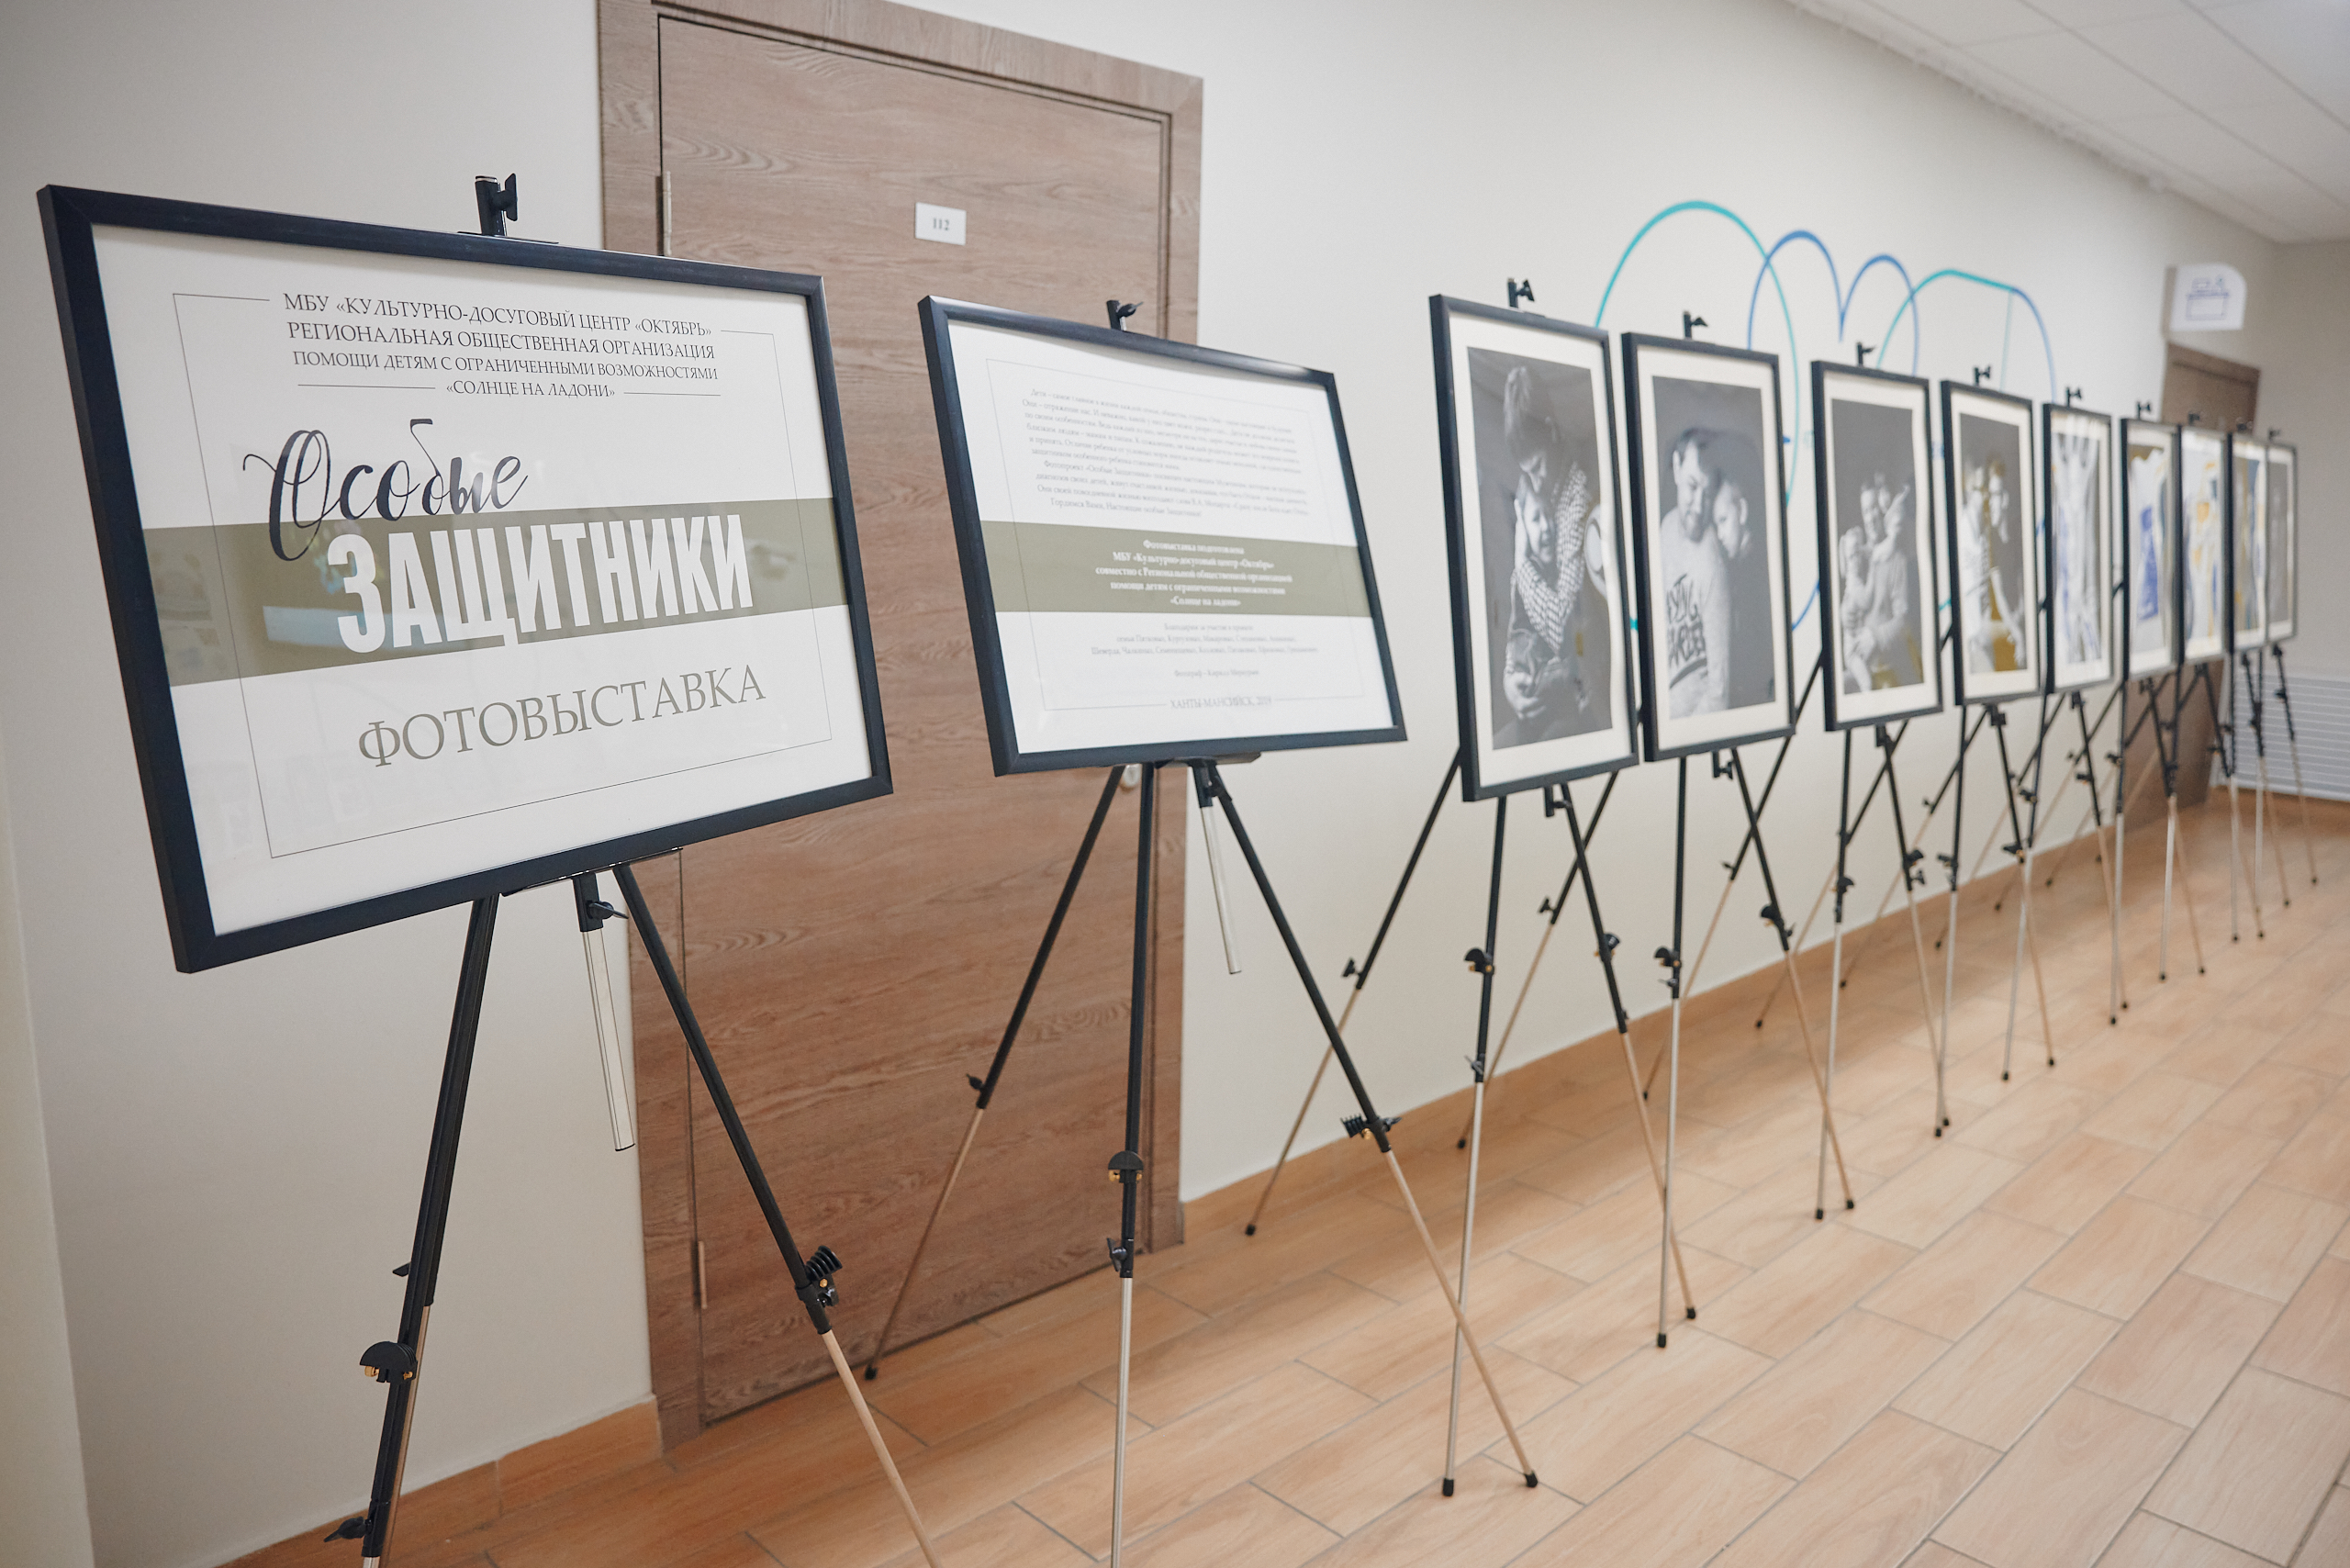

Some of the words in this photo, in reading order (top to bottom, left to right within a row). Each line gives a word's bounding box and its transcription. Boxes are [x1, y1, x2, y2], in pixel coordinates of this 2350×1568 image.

[933, 218, 950, 231] 112
[283, 293, 330, 312] МБУ
[336, 297, 575, 328] «КУЛЬТУРНО-ДОСУГОВЫЙ
[577, 314, 631, 332] ЦЕНТР
[635, 319, 711, 337] «ОКТЯБРЬ»
[287, 321, 453, 346] РЕГИОНАЛЬНАЯ
[457, 331, 599, 353] ОБЩЕСТВЕННАЯ
[602, 339, 715, 361] ОРГАНИЗАЦИЯ
[293, 351, 380, 370] ПОМОЩИ
[384, 354, 438, 371] ДЕТЯМ
[441, 356, 453, 371] С
[455, 357, 595, 375] ОГРАНИЧЕННЫМИ
[597, 363, 719, 380] ВОЗМОЖНОСТЯМИ
[446, 380, 519, 398] «СОЛНЦЕ
[521, 382, 544, 396] НА
[548, 383, 615, 398] ЛАДОНИ»
[242, 418, 529, 562] Особые
[326, 514, 754, 654] ЗАЩИТНИКИ
[357, 664, 767, 768] ФОТОВЫСТАВКА
